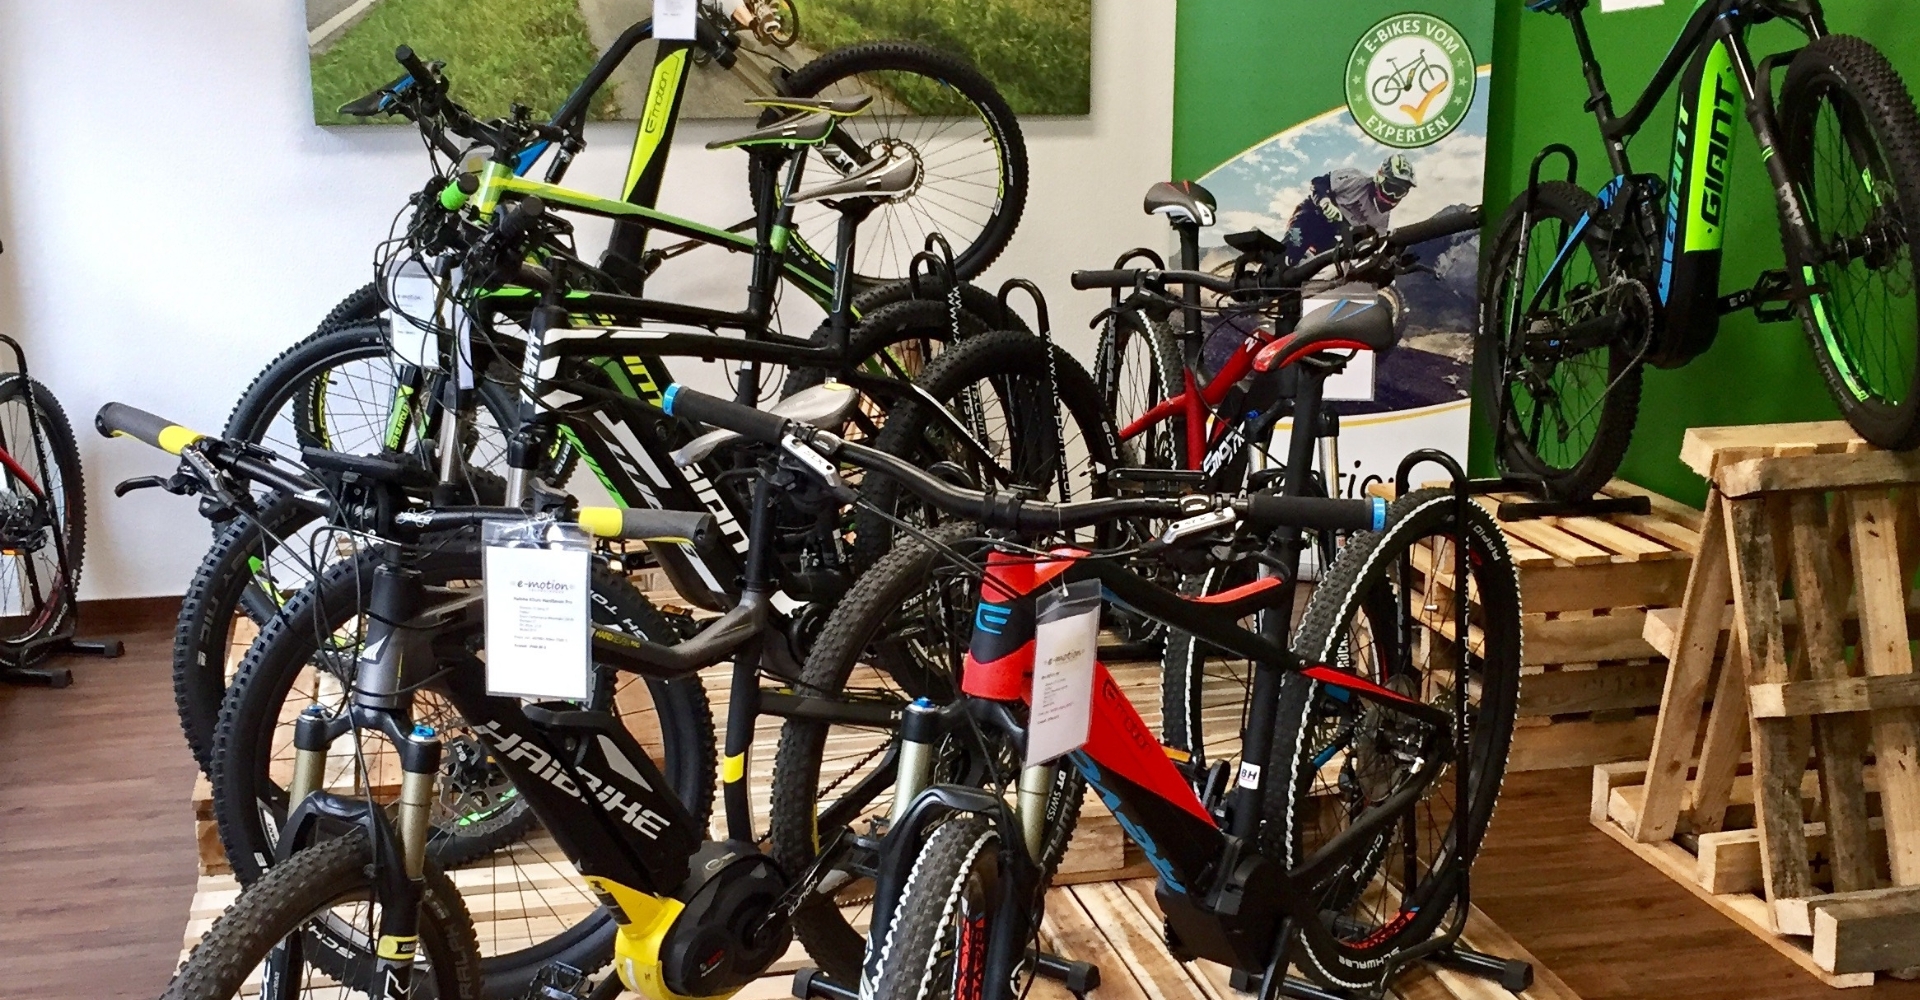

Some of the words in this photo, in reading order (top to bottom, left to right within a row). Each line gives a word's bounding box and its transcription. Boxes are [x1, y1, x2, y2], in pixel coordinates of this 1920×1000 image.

[1364, 20, 1420, 53] E-BIKES
[1425, 22, 1459, 54] VOM
[1366, 115, 1449, 142] EXPERTEN
[1701, 72, 1734, 227] GIANT
[679, 461, 750, 555] GIAN
[472, 720, 671, 840] HAIBIKE
[1057, 769, 1067, 790] DT
[1241, 768, 1257, 780] BH
[1046, 790, 1062, 822] SWISS
